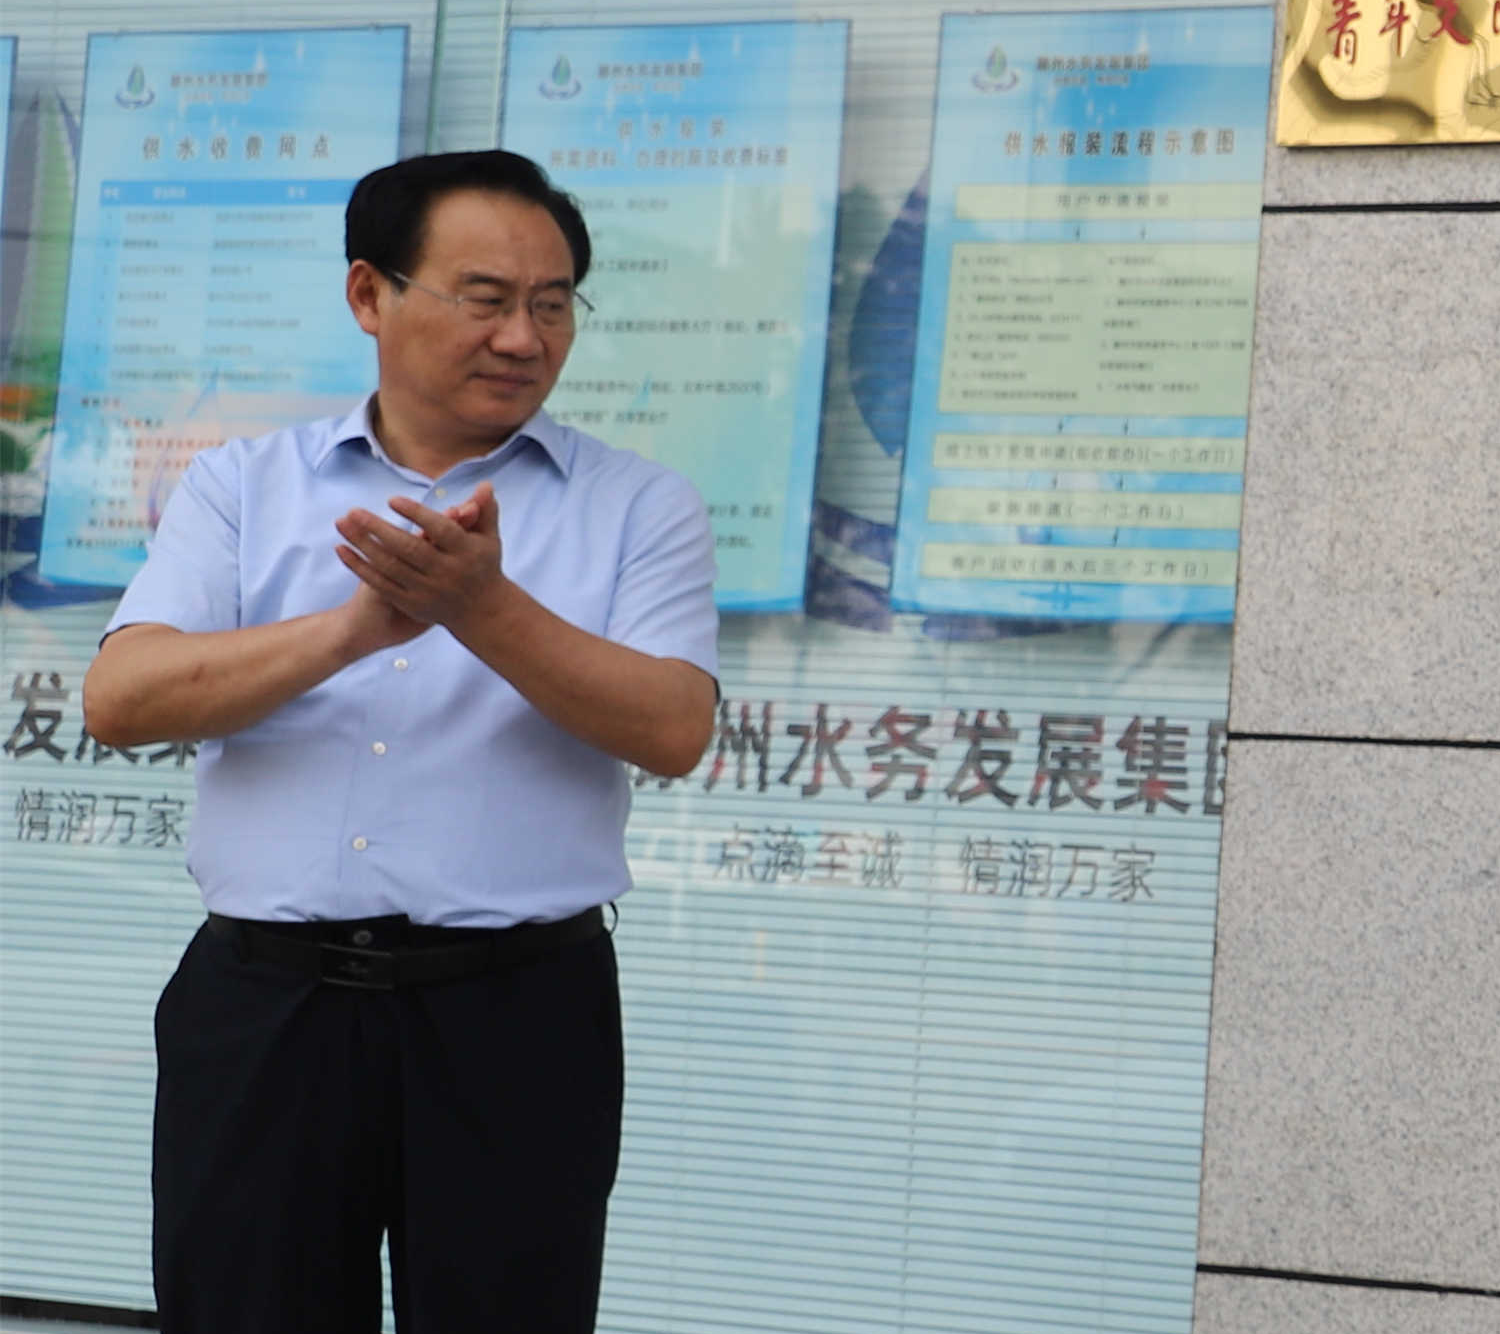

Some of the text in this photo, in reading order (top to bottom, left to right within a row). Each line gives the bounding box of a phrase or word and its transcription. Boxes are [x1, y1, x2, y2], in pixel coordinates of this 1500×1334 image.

[1003, 127, 1236, 157] 供水报装流程示意图
[632, 698, 1228, 817] 州水务发展集
[14, 786, 188, 848] 情润万家
[715, 820, 1161, 904] 点滴至诚 情润万家
